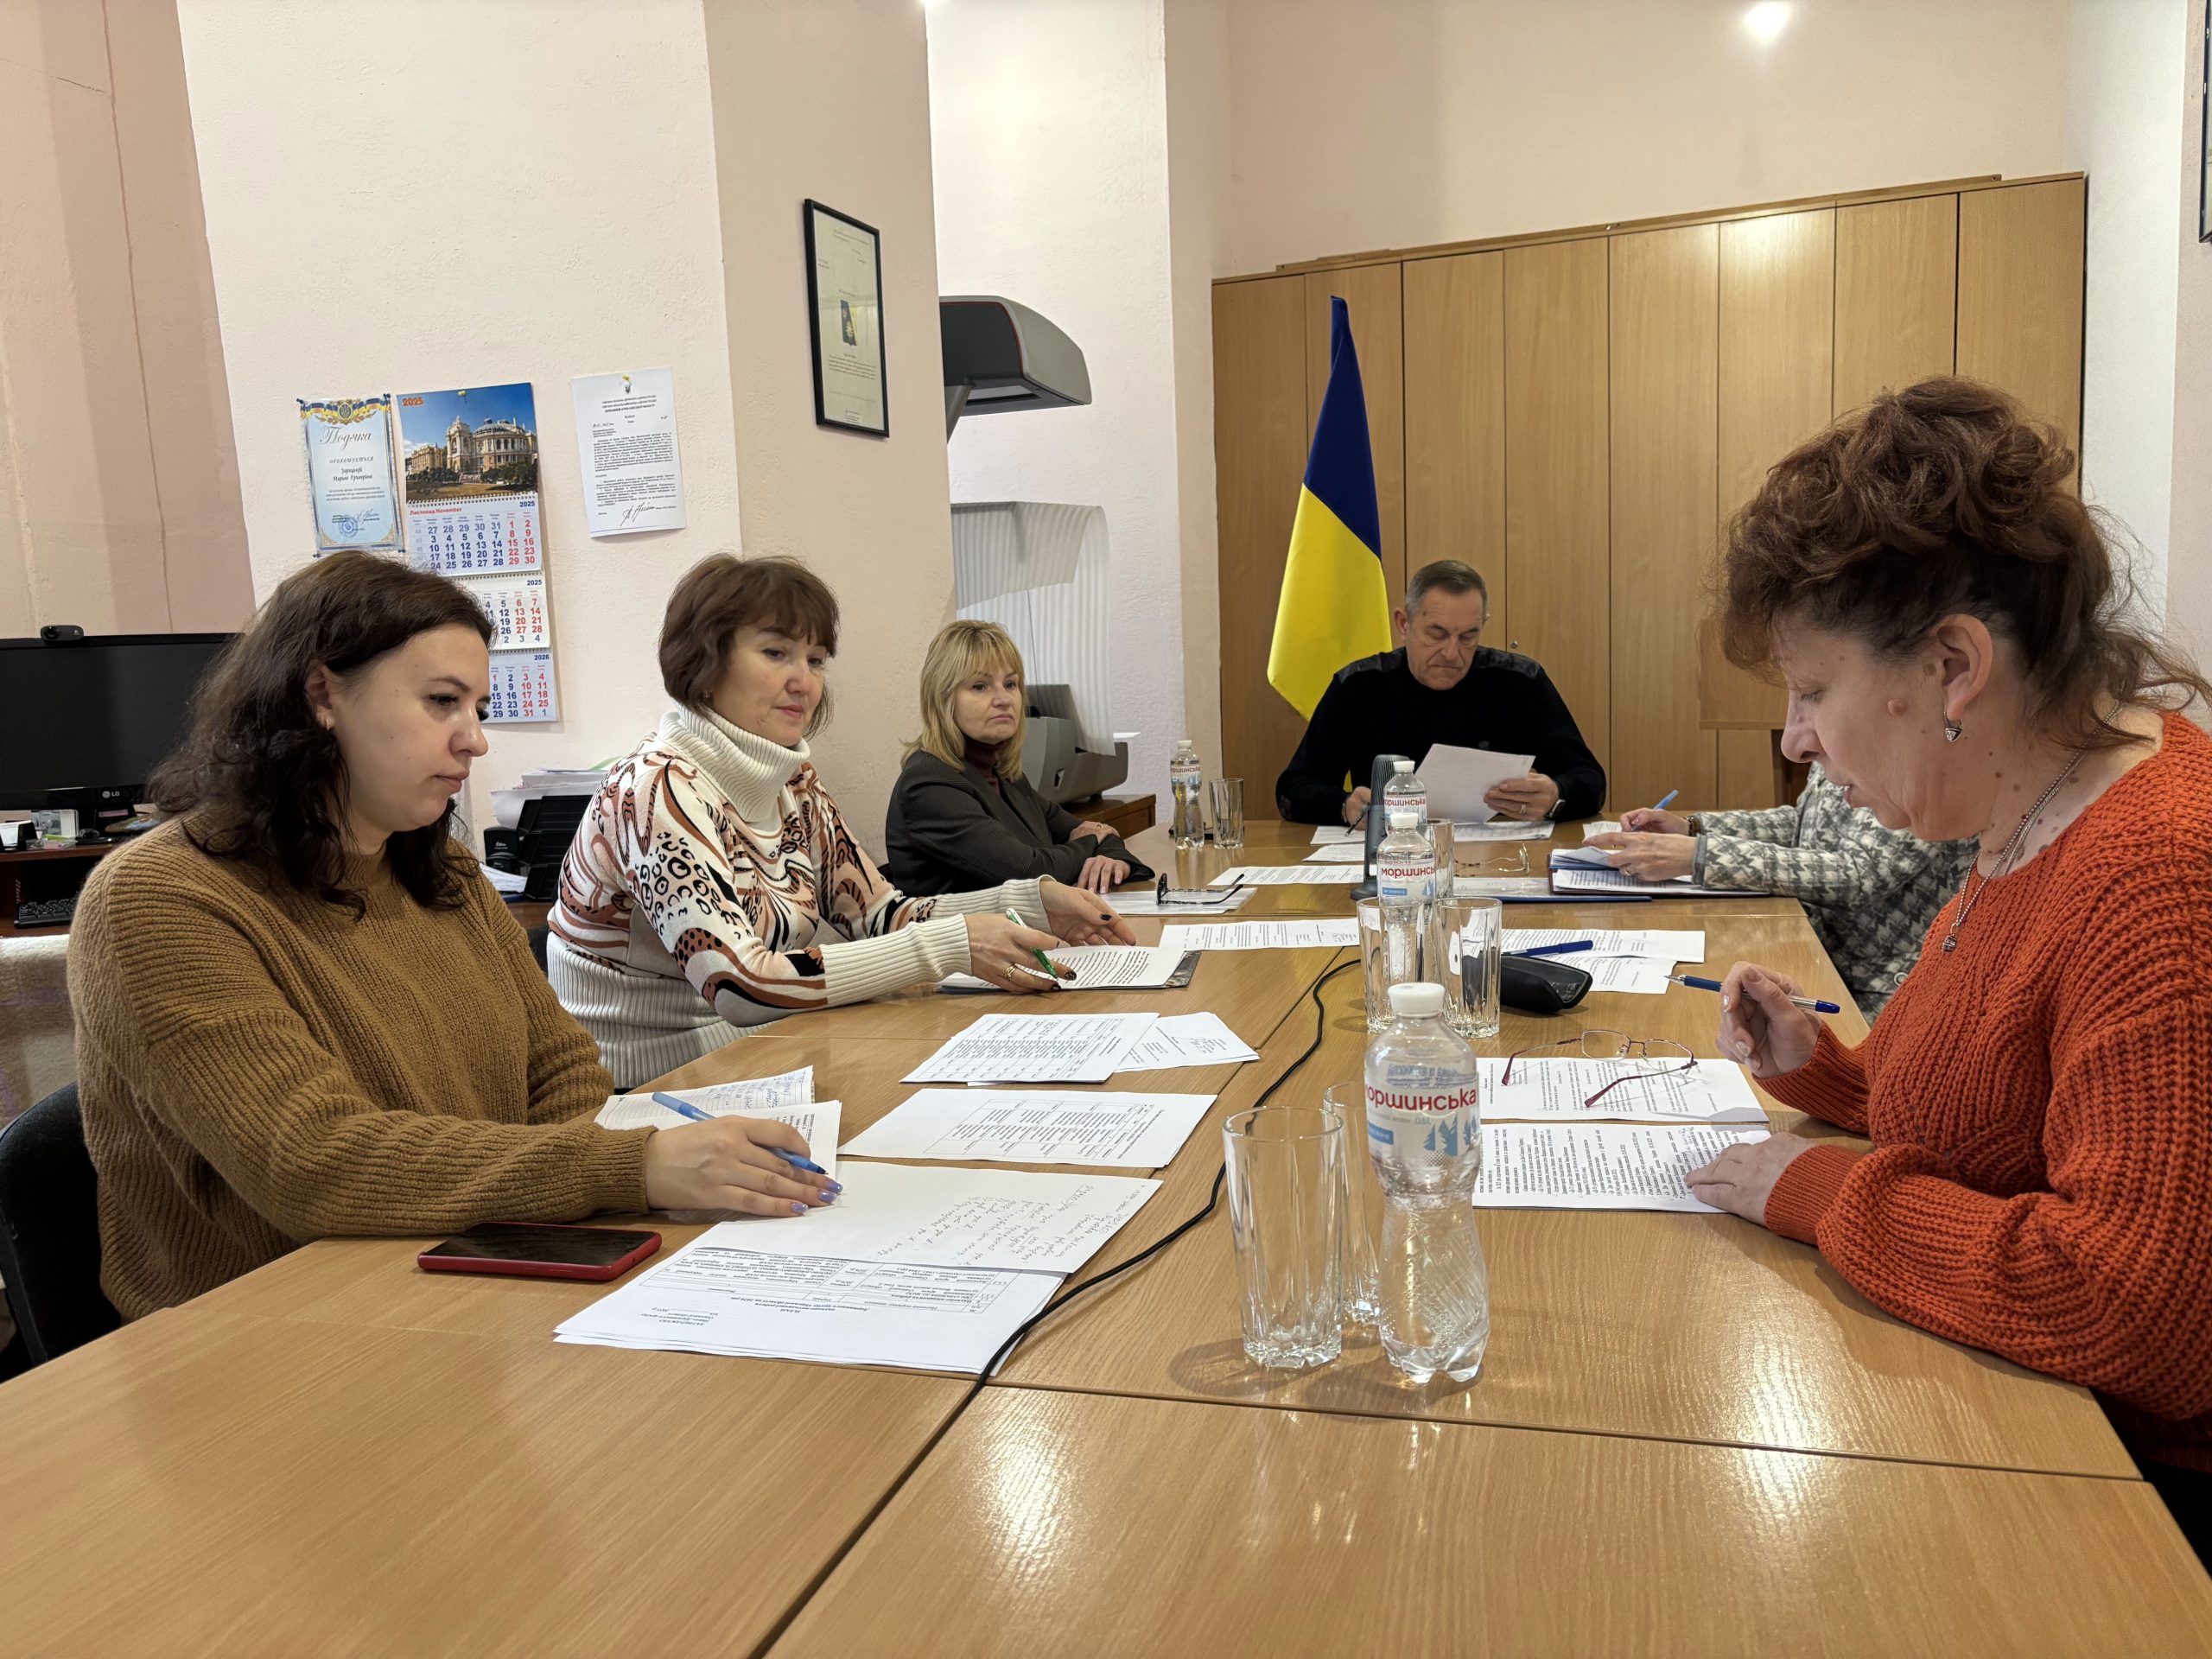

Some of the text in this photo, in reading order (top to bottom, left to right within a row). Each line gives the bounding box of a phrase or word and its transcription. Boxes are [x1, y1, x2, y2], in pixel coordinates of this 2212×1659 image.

[402, 397, 424, 406] 2025
[320, 426, 372, 449] Подяка
[443, 525, 453, 533] 28
[491, 521, 501, 530] 31
[1383, 796, 1425, 806] оршинська
[1381, 866, 1436, 878] моршинсь
[1366, 1085, 1477, 1111] оршинська
